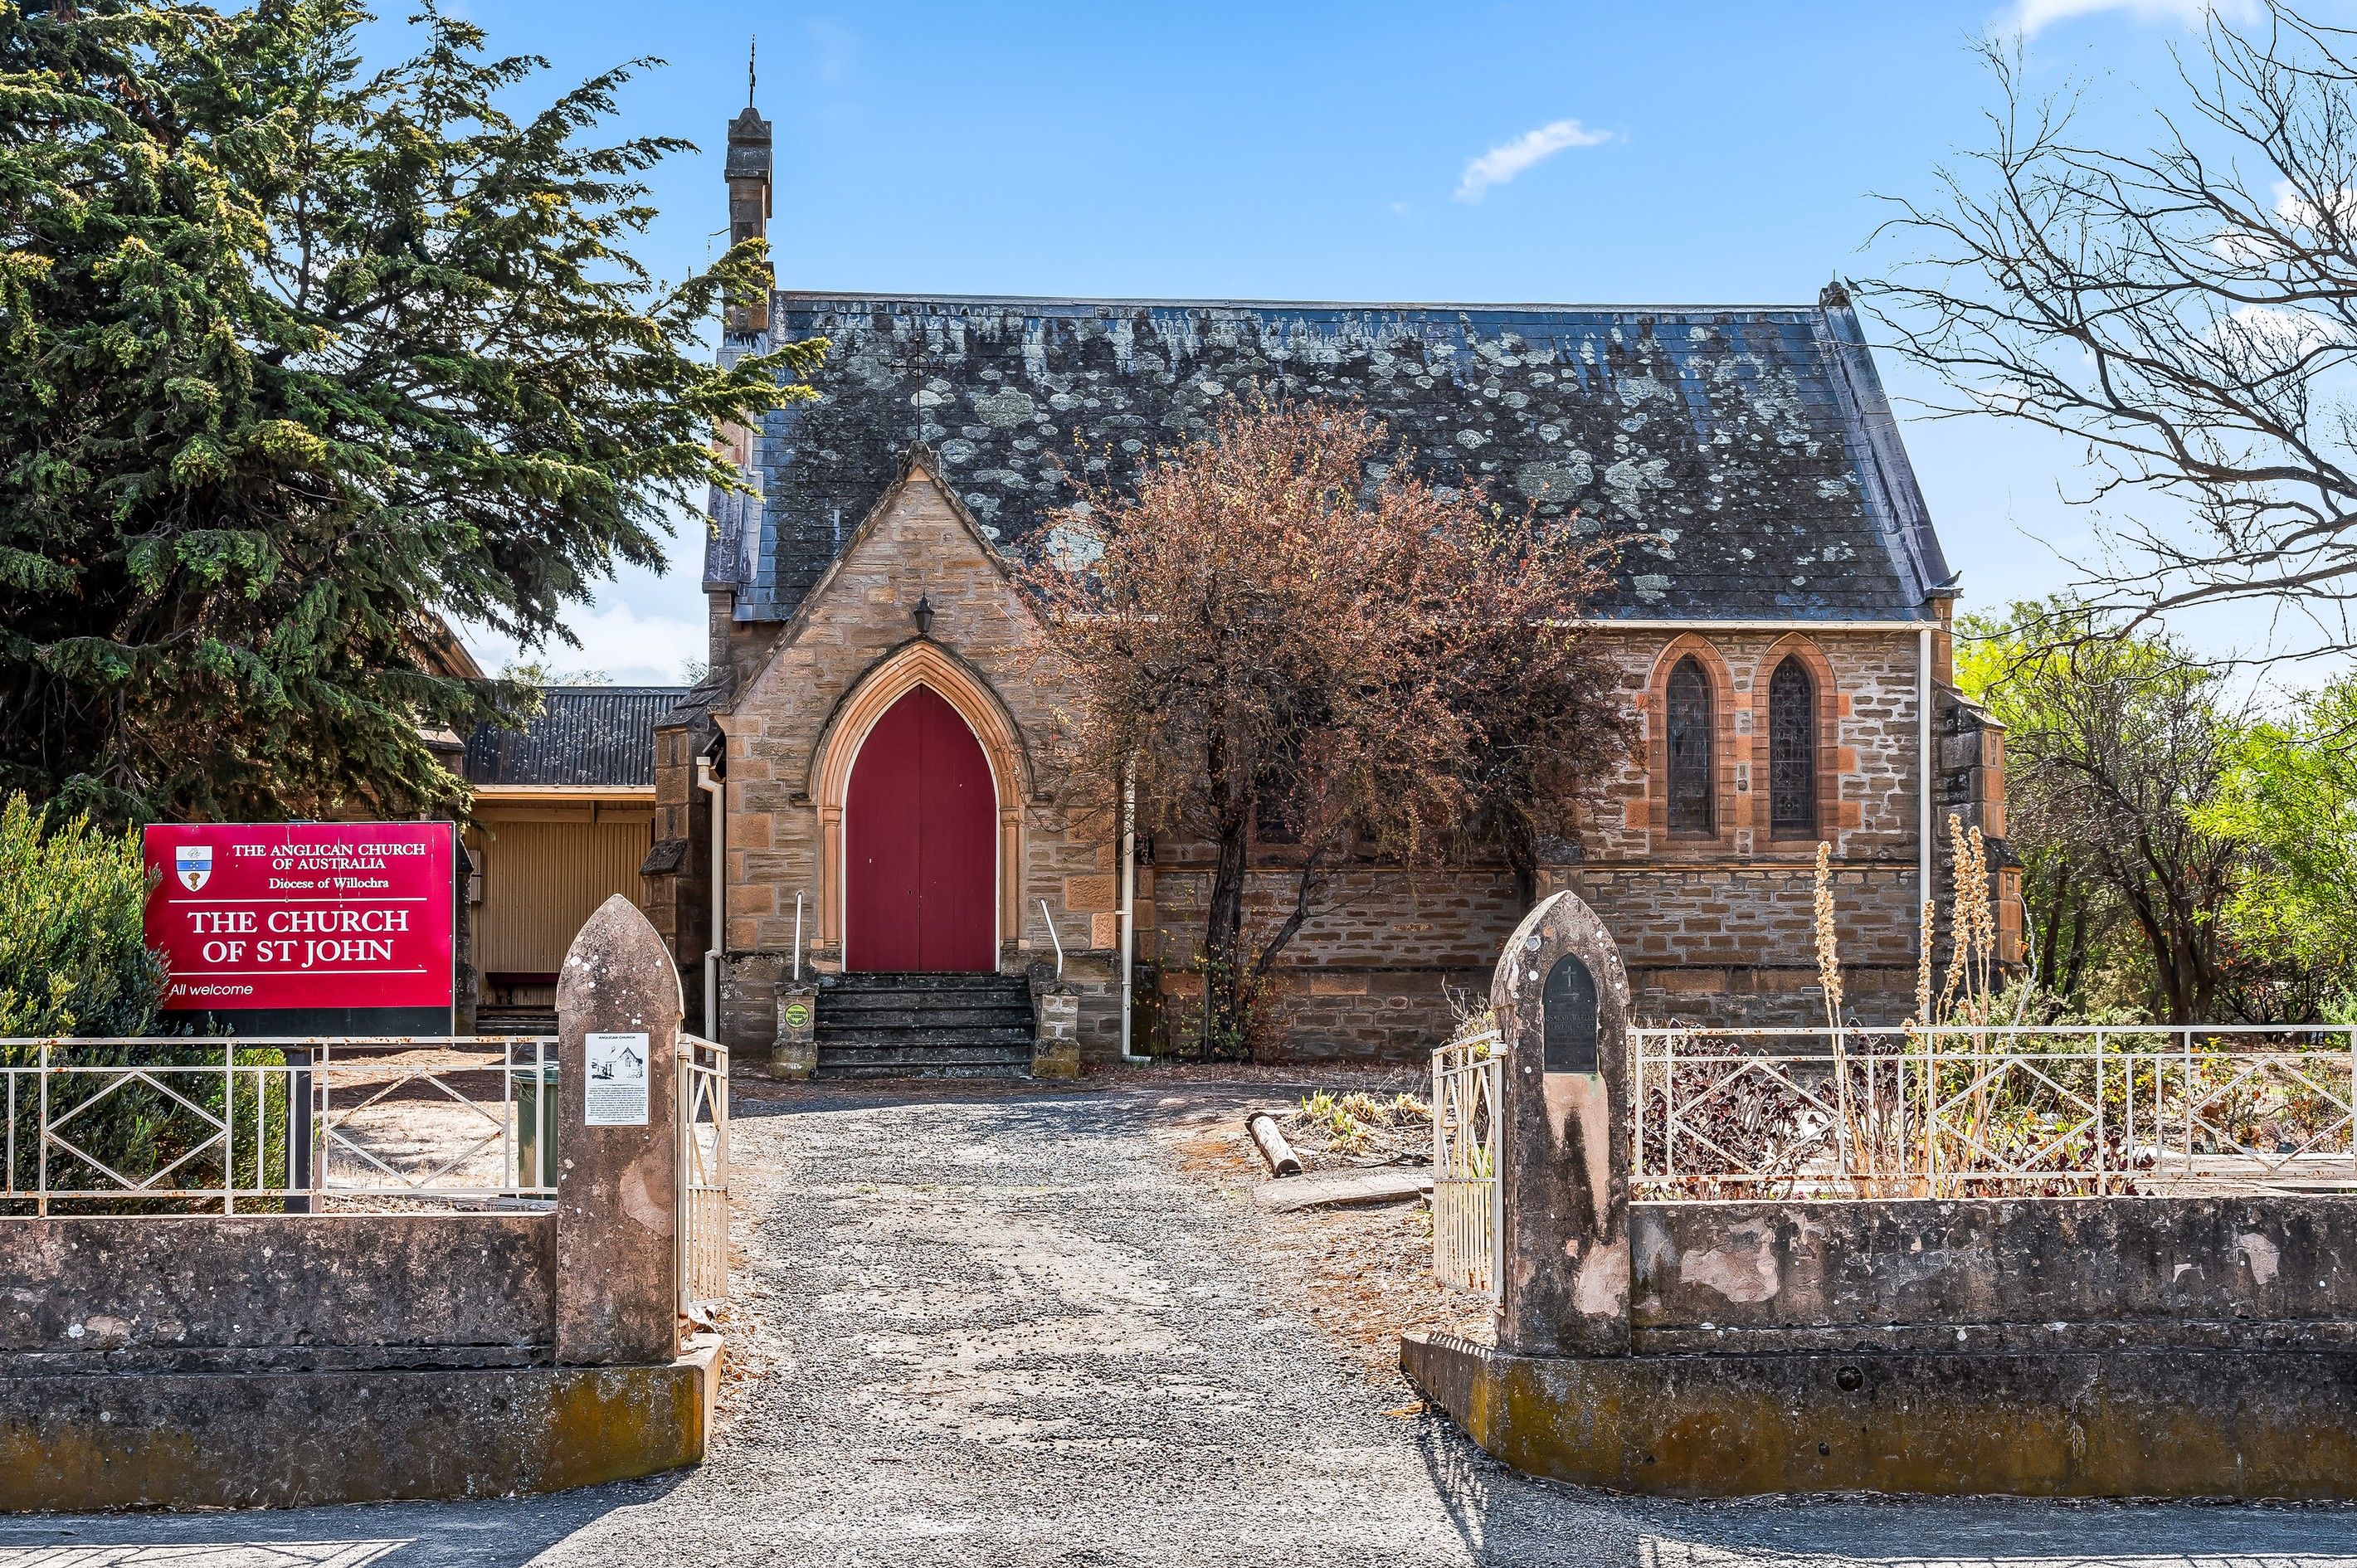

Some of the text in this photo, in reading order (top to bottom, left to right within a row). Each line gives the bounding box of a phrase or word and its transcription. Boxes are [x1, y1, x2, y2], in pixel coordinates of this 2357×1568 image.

[232, 844, 426, 856] THE ANGLICAN CHURCH
[272, 858, 386, 869] OF AUSTRALIA
[269, 878, 389, 889] Diocese of Willochra
[187, 910, 409, 933] THE CHURCH
[202, 939, 393, 968] OF ST JOHN
[169, 984, 253, 996] All welcome
